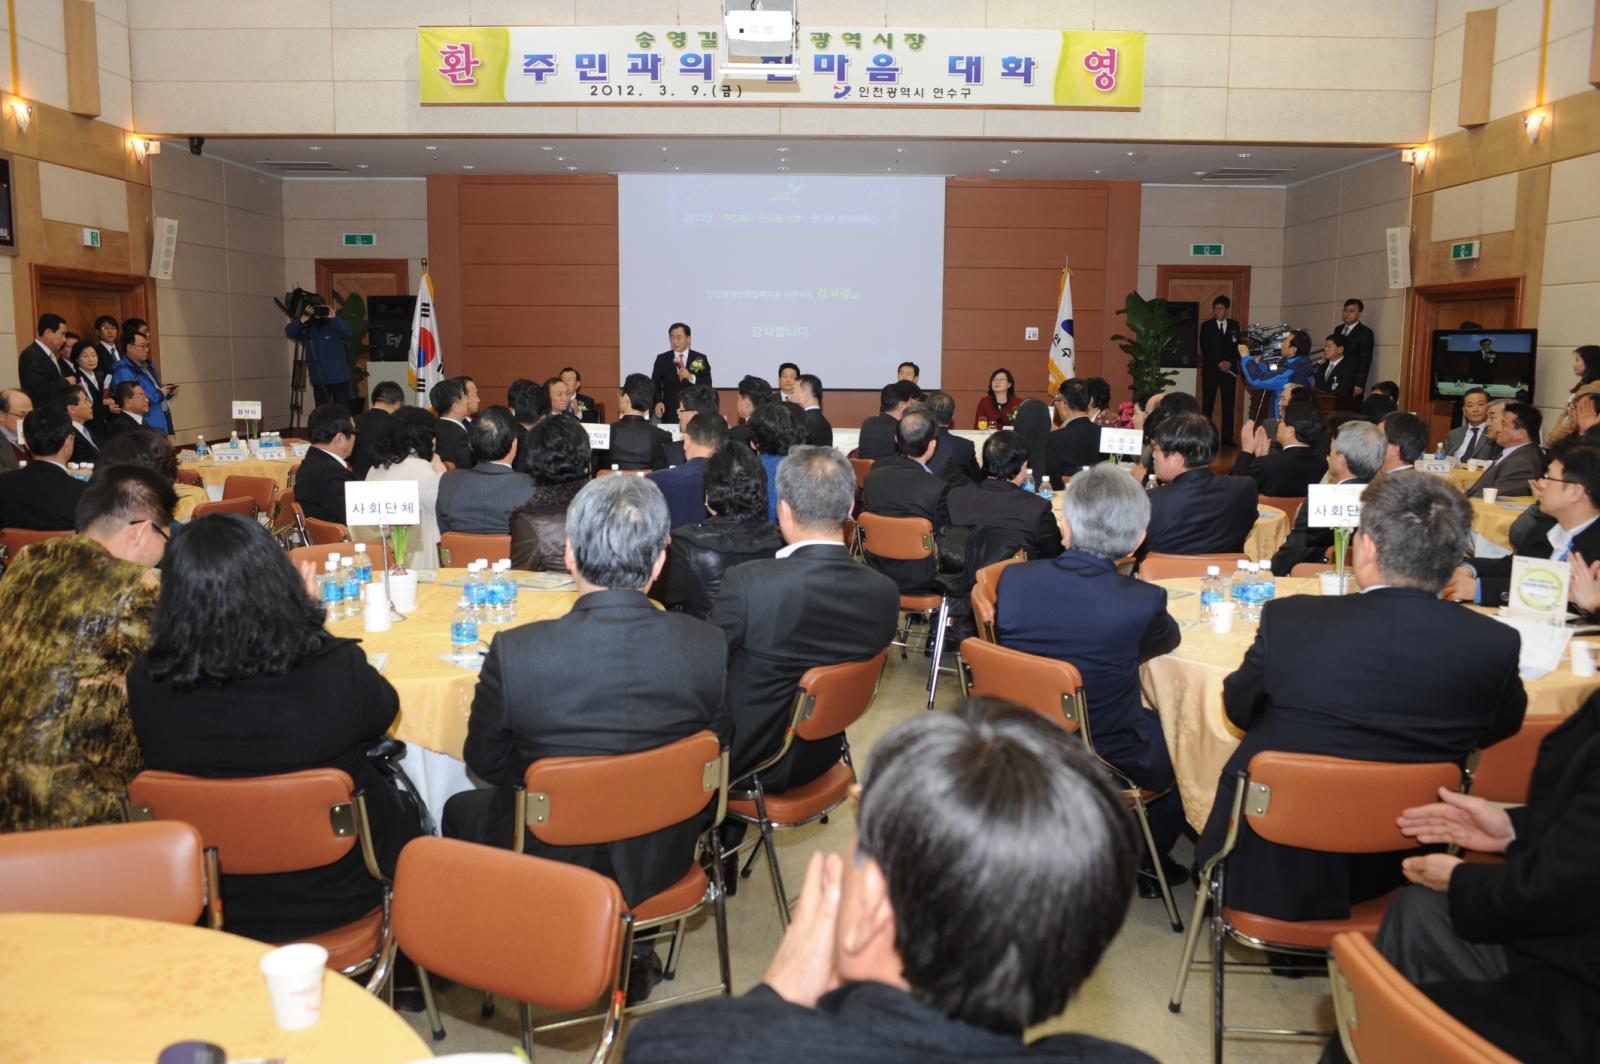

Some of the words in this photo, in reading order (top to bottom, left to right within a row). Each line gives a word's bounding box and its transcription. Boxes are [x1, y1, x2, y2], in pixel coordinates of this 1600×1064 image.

[634, 31, 719, 49] 송영길
[809, 32, 926, 51] 광역시장
[437, 42, 481, 86] 환
[522, 52, 714, 83] 주민과의
[947, 54, 1036, 86] 대화
[1083, 46, 1118, 92] 영
[589, 84, 643, 97] 2012.
[658, 84, 676, 97] 3.
[858, 86, 925, 99] 인천광역시
[932, 87, 972, 99] 연수구
[351, 501, 414, 514] 사회단체
[1314, 504, 1361, 517] 사회단
